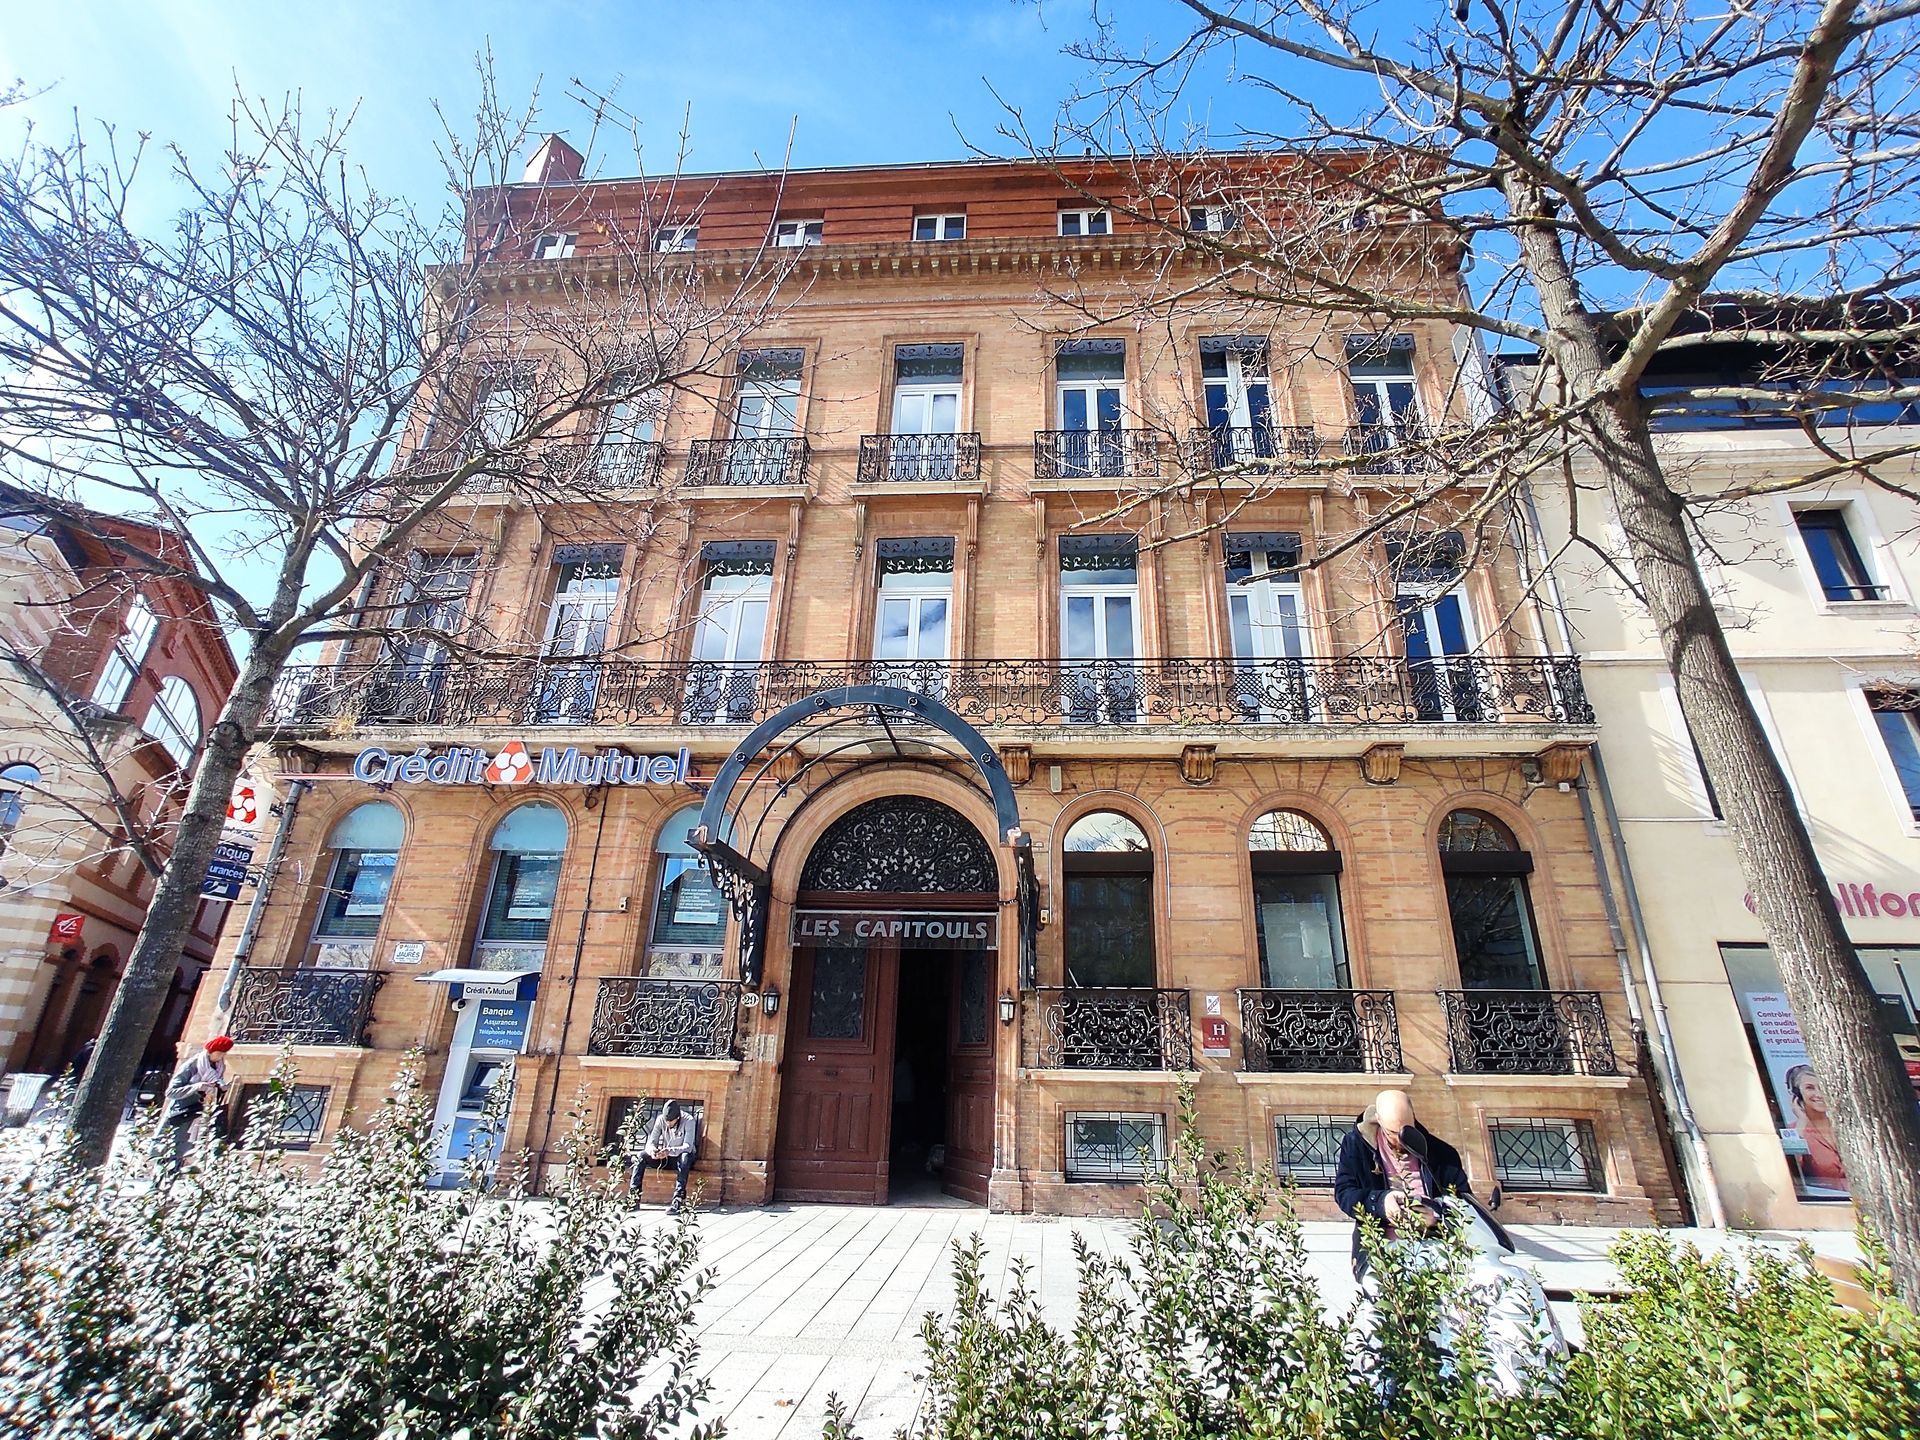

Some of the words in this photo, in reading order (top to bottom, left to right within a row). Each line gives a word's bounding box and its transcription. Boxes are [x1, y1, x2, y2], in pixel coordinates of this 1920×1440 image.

[353, 746, 489, 784] Crédit
[536, 747, 690, 785] Mutuel
[215, 846, 249, 861] nque
[209, 865, 244, 878] urances
[801, 919, 840, 937] LES
[855, 920, 988, 939] CAPITOULS
[465, 986, 485, 994] Crédit
[492, 987, 515, 995] Mutuel
[482, 1007, 514, 1017] Banque
[1757, 1010, 1792, 1018] Contrôler
[483, 1018, 518, 1026] Assurances
[1213, 1024, 1225, 1035] H
[486, 1038, 513, 1046] Crédits
